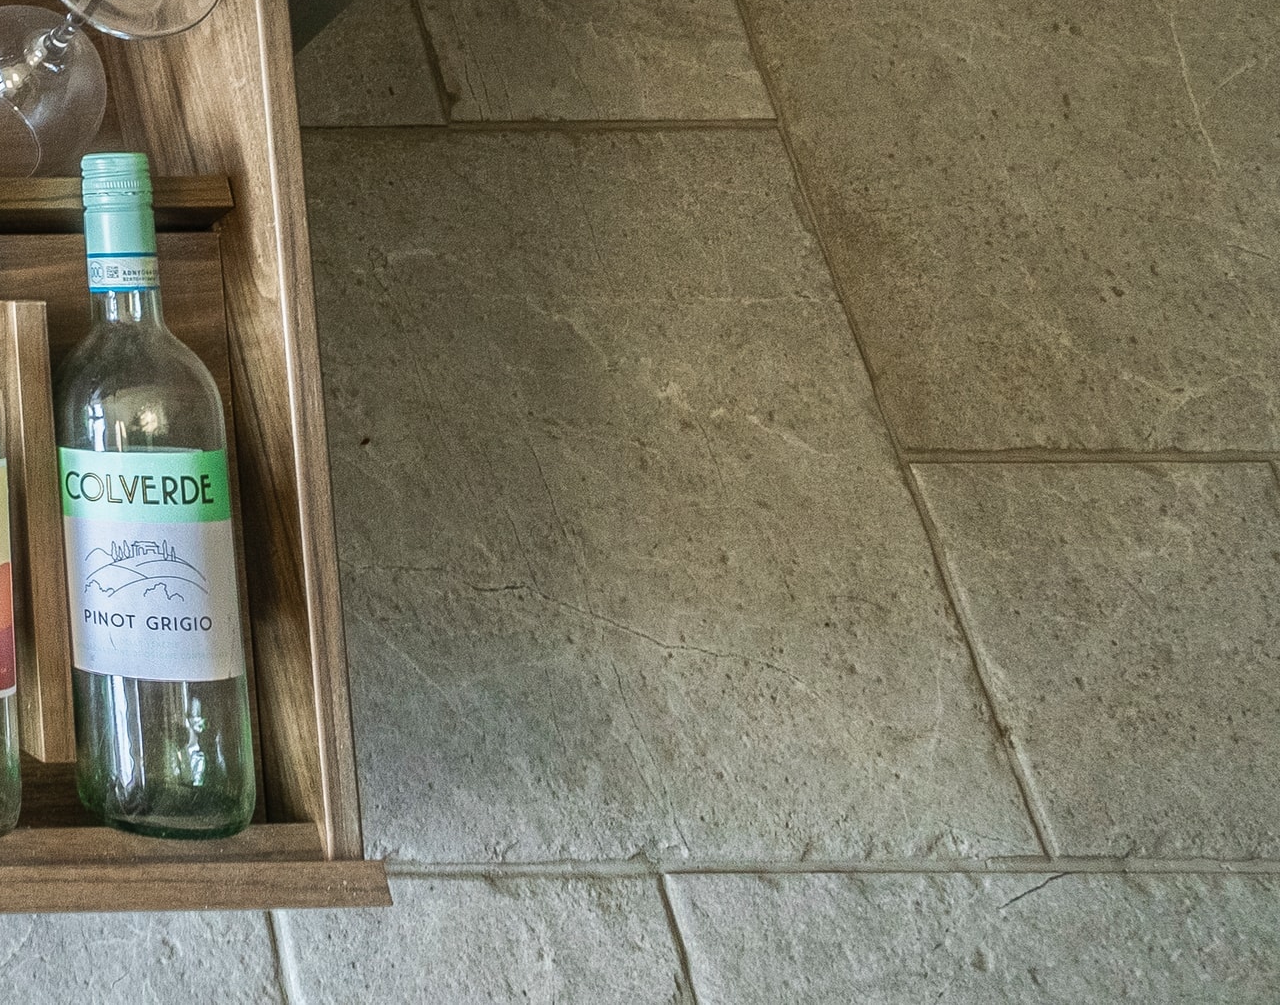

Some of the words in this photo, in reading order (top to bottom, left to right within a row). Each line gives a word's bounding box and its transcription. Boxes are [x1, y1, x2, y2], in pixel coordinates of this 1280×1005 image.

[65, 471, 214, 506] COLVERDE
[84, 609, 135, 629] PINOT
[146, 615, 212, 631] GRIGIO
